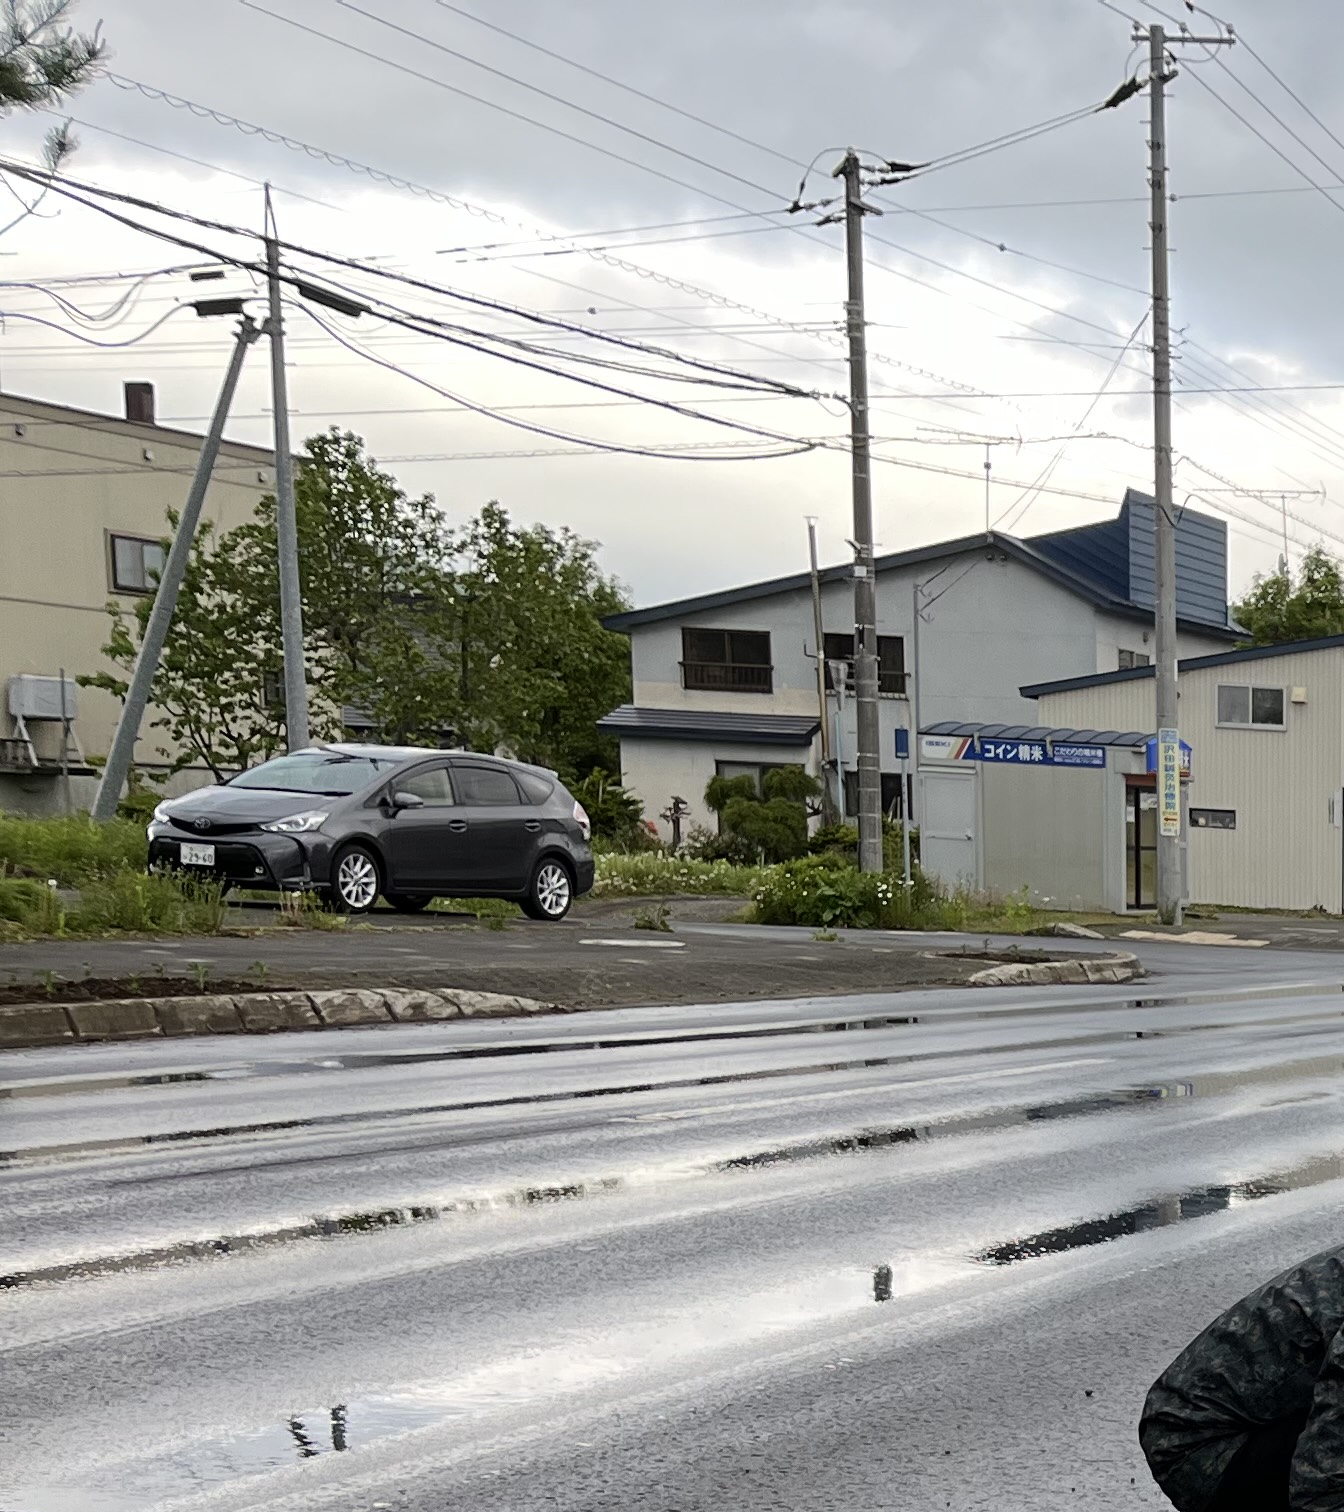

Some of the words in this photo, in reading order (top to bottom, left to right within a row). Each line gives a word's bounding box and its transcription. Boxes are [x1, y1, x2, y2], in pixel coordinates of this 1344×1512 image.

[984, 744, 1043, 761] コイン精米
